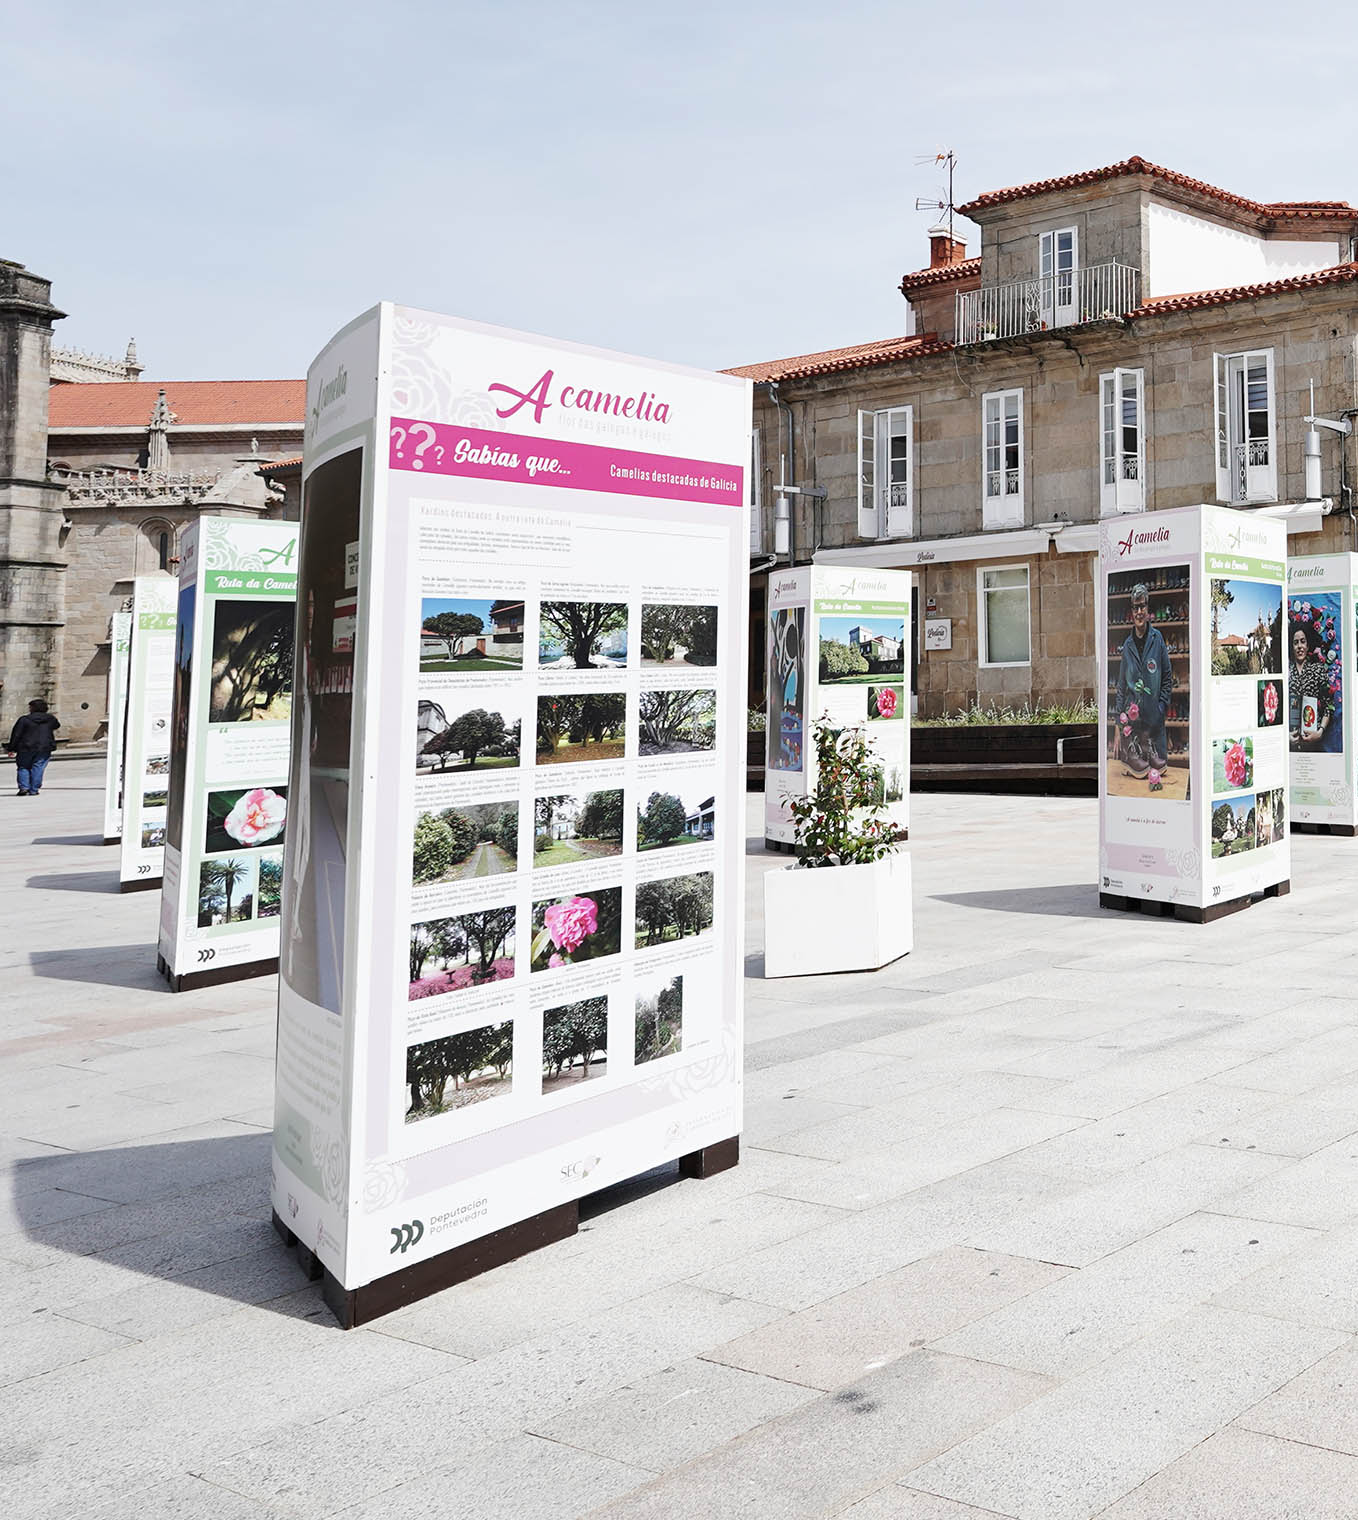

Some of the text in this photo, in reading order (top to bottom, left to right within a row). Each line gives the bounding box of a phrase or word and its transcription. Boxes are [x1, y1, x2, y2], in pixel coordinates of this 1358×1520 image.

[488, 369, 673, 425] A camelia
[453, 439, 521, 468] Sabías
[525, 455, 571, 477] que...
[610, 464, 737, 492] Camelias destacadas de Galicia
[258, 538, 297, 566] A
[1118, 527, 1170, 556] A camelia
[215, 576, 243, 589] Ruta
[246, 579, 260, 589] da
[1293, 565, 1324, 578] camelia
[430, 1197, 488, 1225] Deputación
[430, 1208, 488, 1235] Pontevedra
